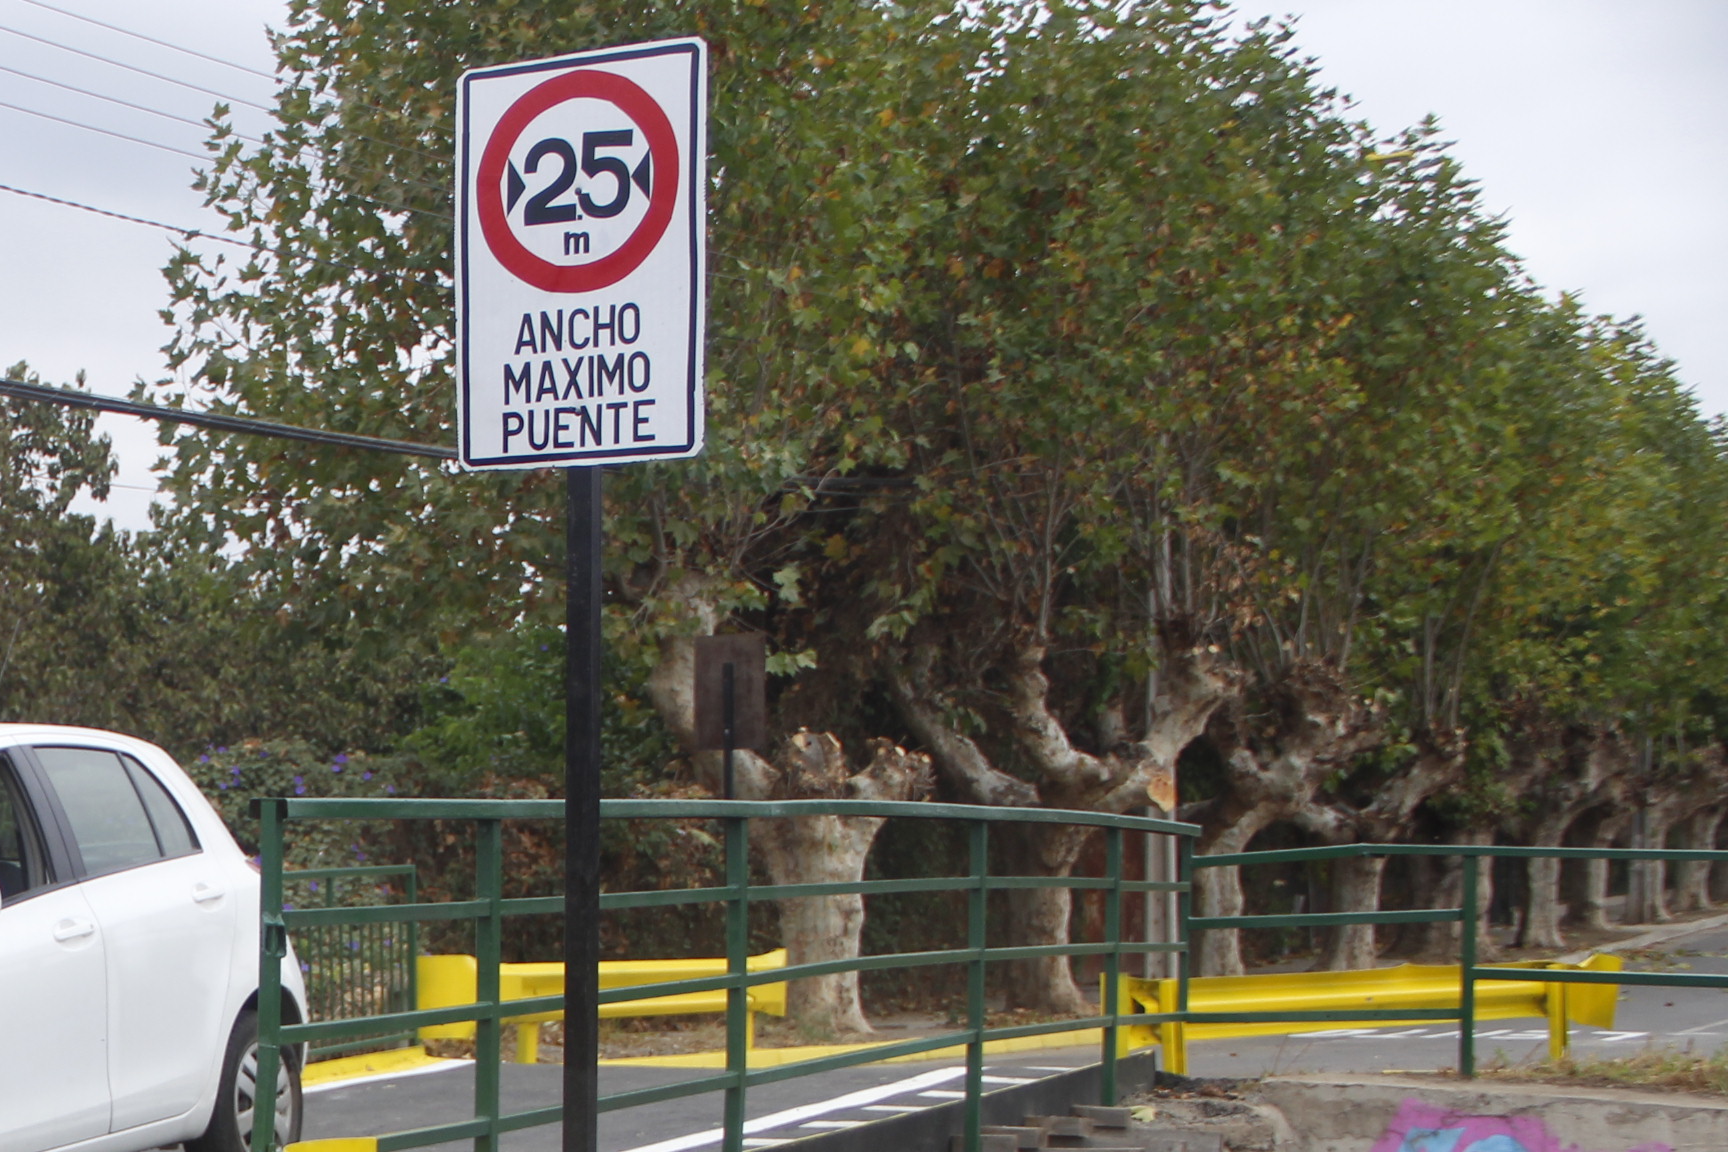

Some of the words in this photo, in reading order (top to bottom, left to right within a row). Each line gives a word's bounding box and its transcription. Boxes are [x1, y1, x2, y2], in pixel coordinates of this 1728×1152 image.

[563, 230, 590, 256] m
[514, 302, 641, 356] ANCHO
[503, 351, 651, 405] MAXIMO
[502, 398, 656, 454] PUENTE
